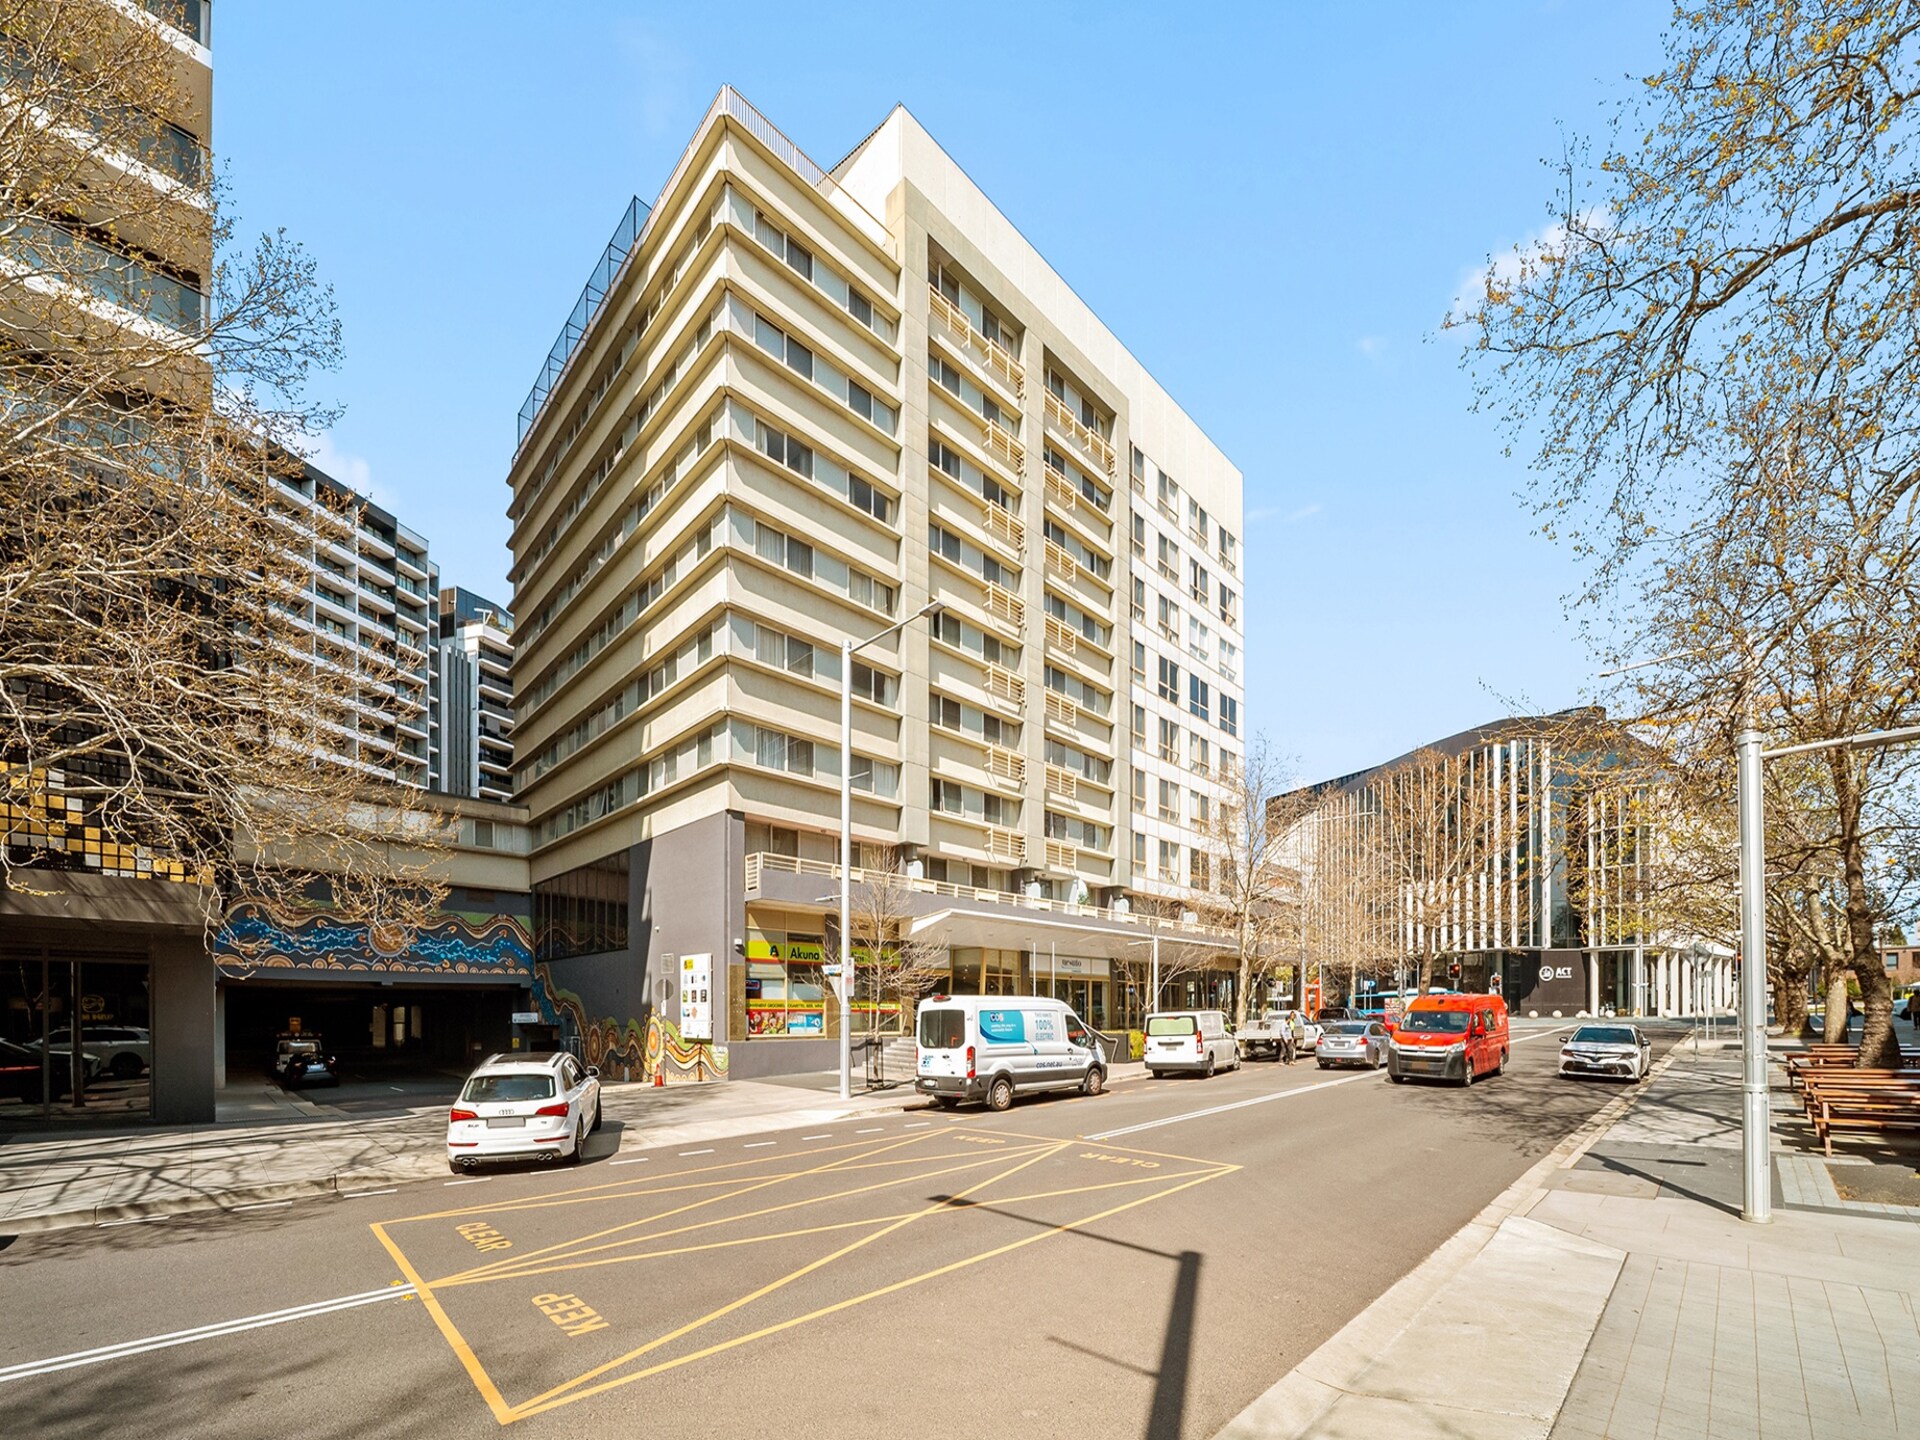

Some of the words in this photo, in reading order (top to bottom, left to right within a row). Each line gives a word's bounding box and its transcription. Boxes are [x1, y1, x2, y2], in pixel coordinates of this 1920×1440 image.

[790, 947, 820, 960] Akuna
[1556, 967, 1572, 976] ACT
[1035, 1019, 1054, 1030] 100%
[1036, 1061, 1063, 1069] cos.net.au
[1079, 1152, 1161, 1169] CLEAR
[455, 1222, 514, 1253] CLEAR
[531, 1293, 610, 1337] KEEP
